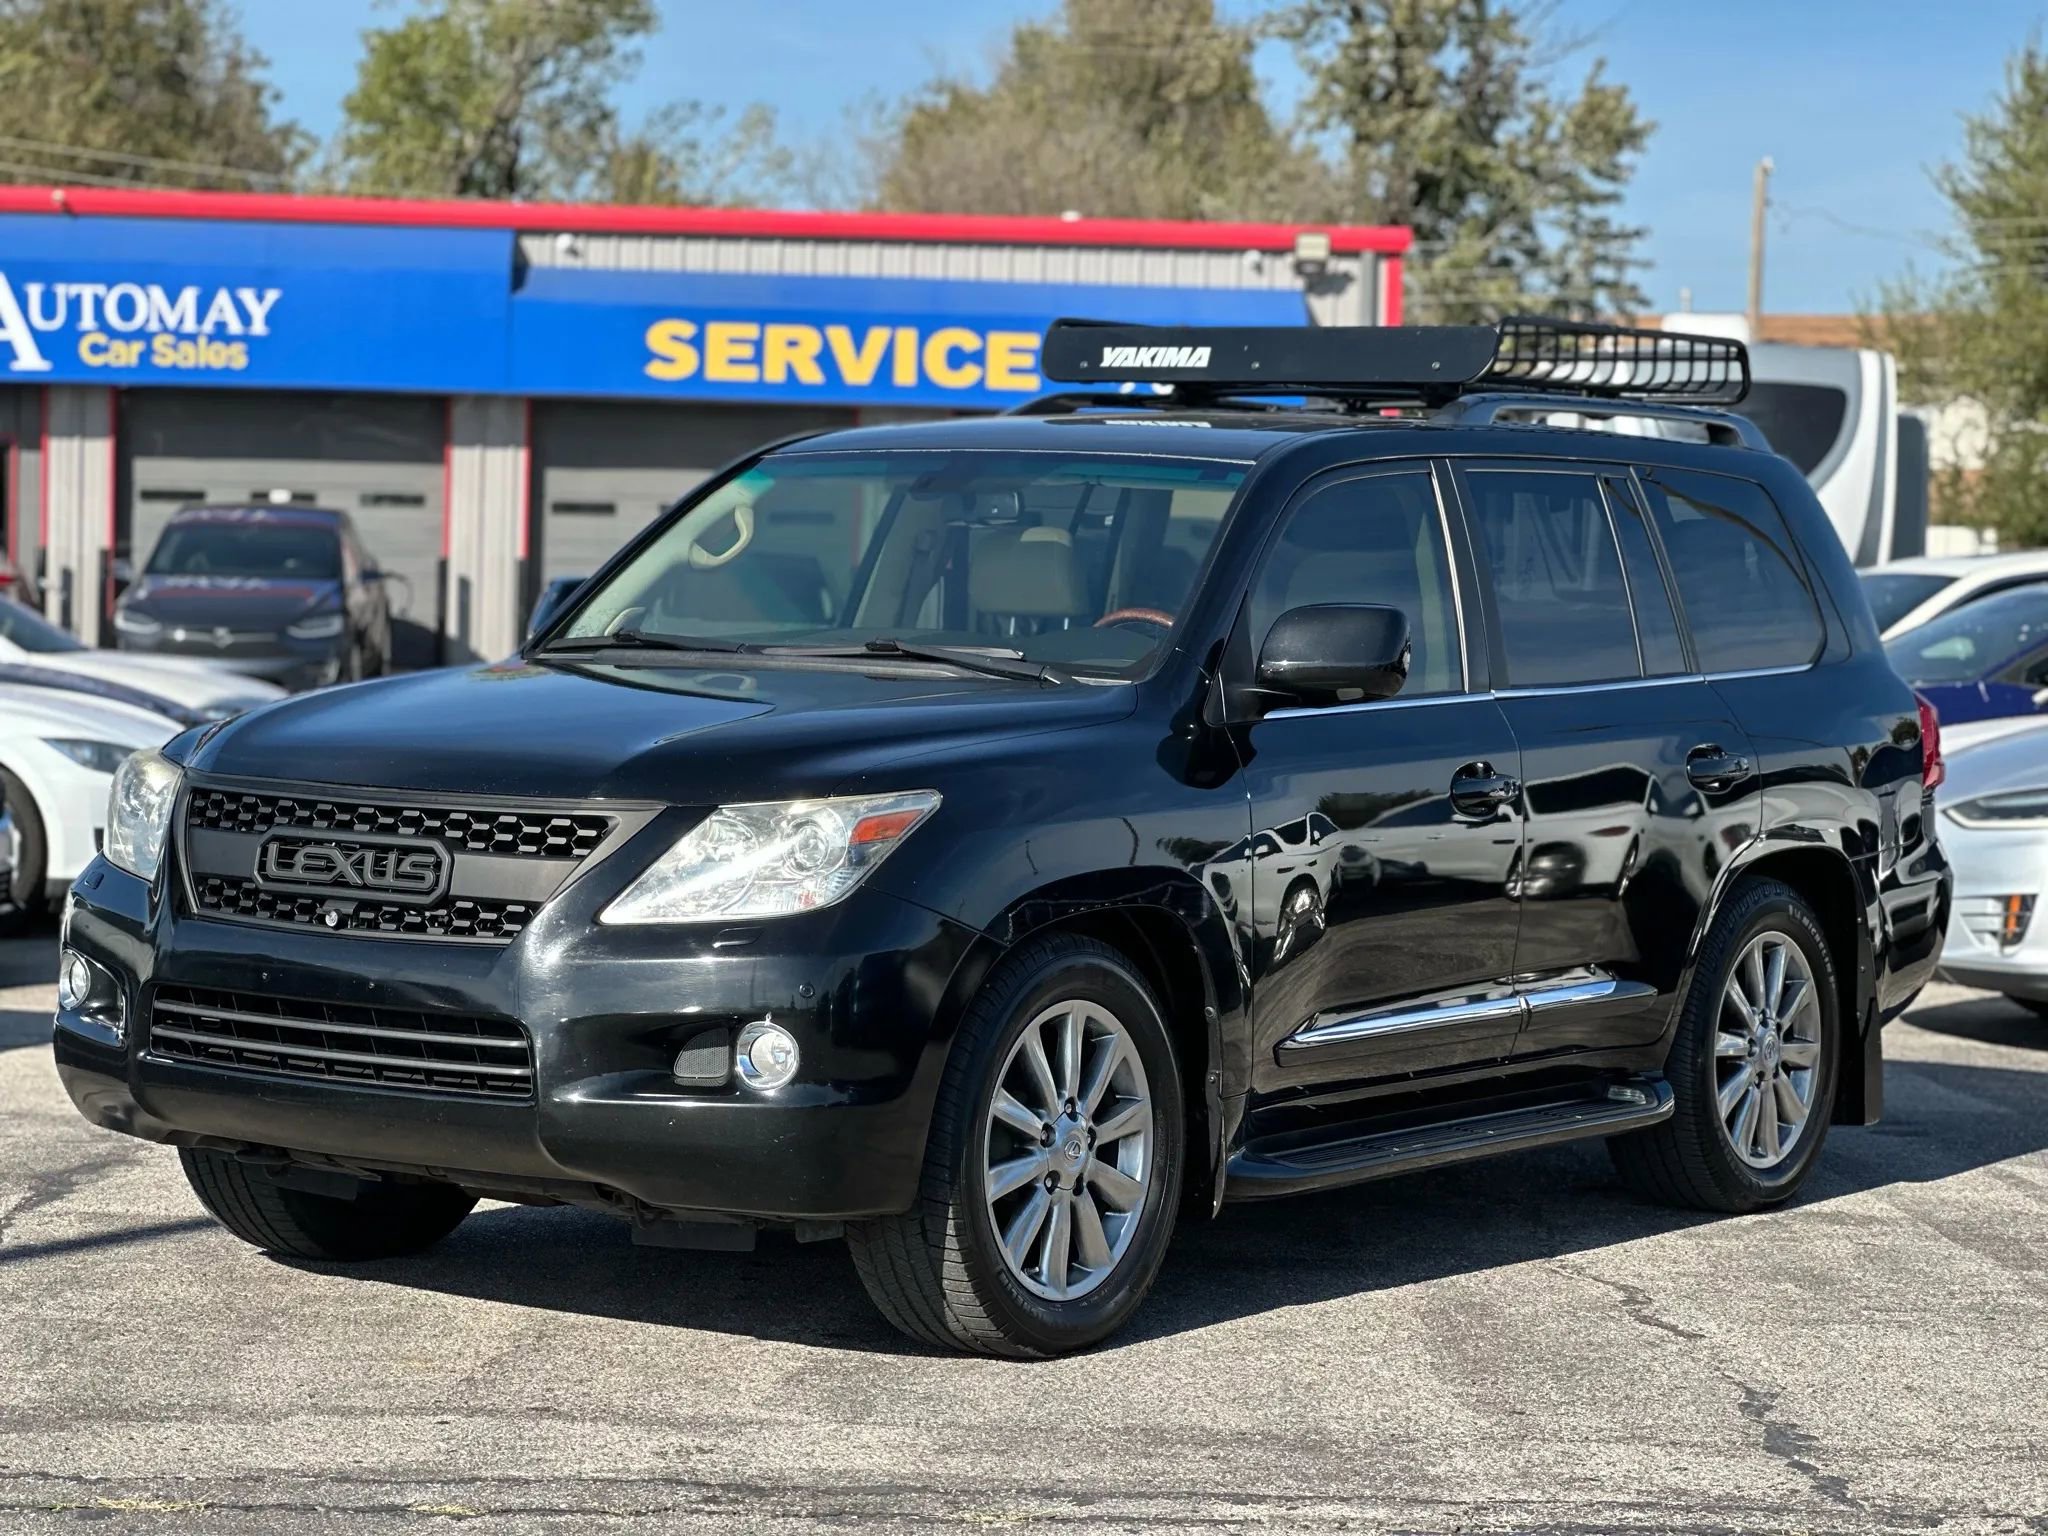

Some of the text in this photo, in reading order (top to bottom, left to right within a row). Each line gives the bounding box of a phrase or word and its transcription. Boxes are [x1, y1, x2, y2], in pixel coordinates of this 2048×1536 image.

[78, 331, 248, 370] Car Sales
[644, 318, 1042, 392] SERVICE
[1099, 346, 1212, 367] YAKIMA
[265, 841, 437, 892] LEXUS
